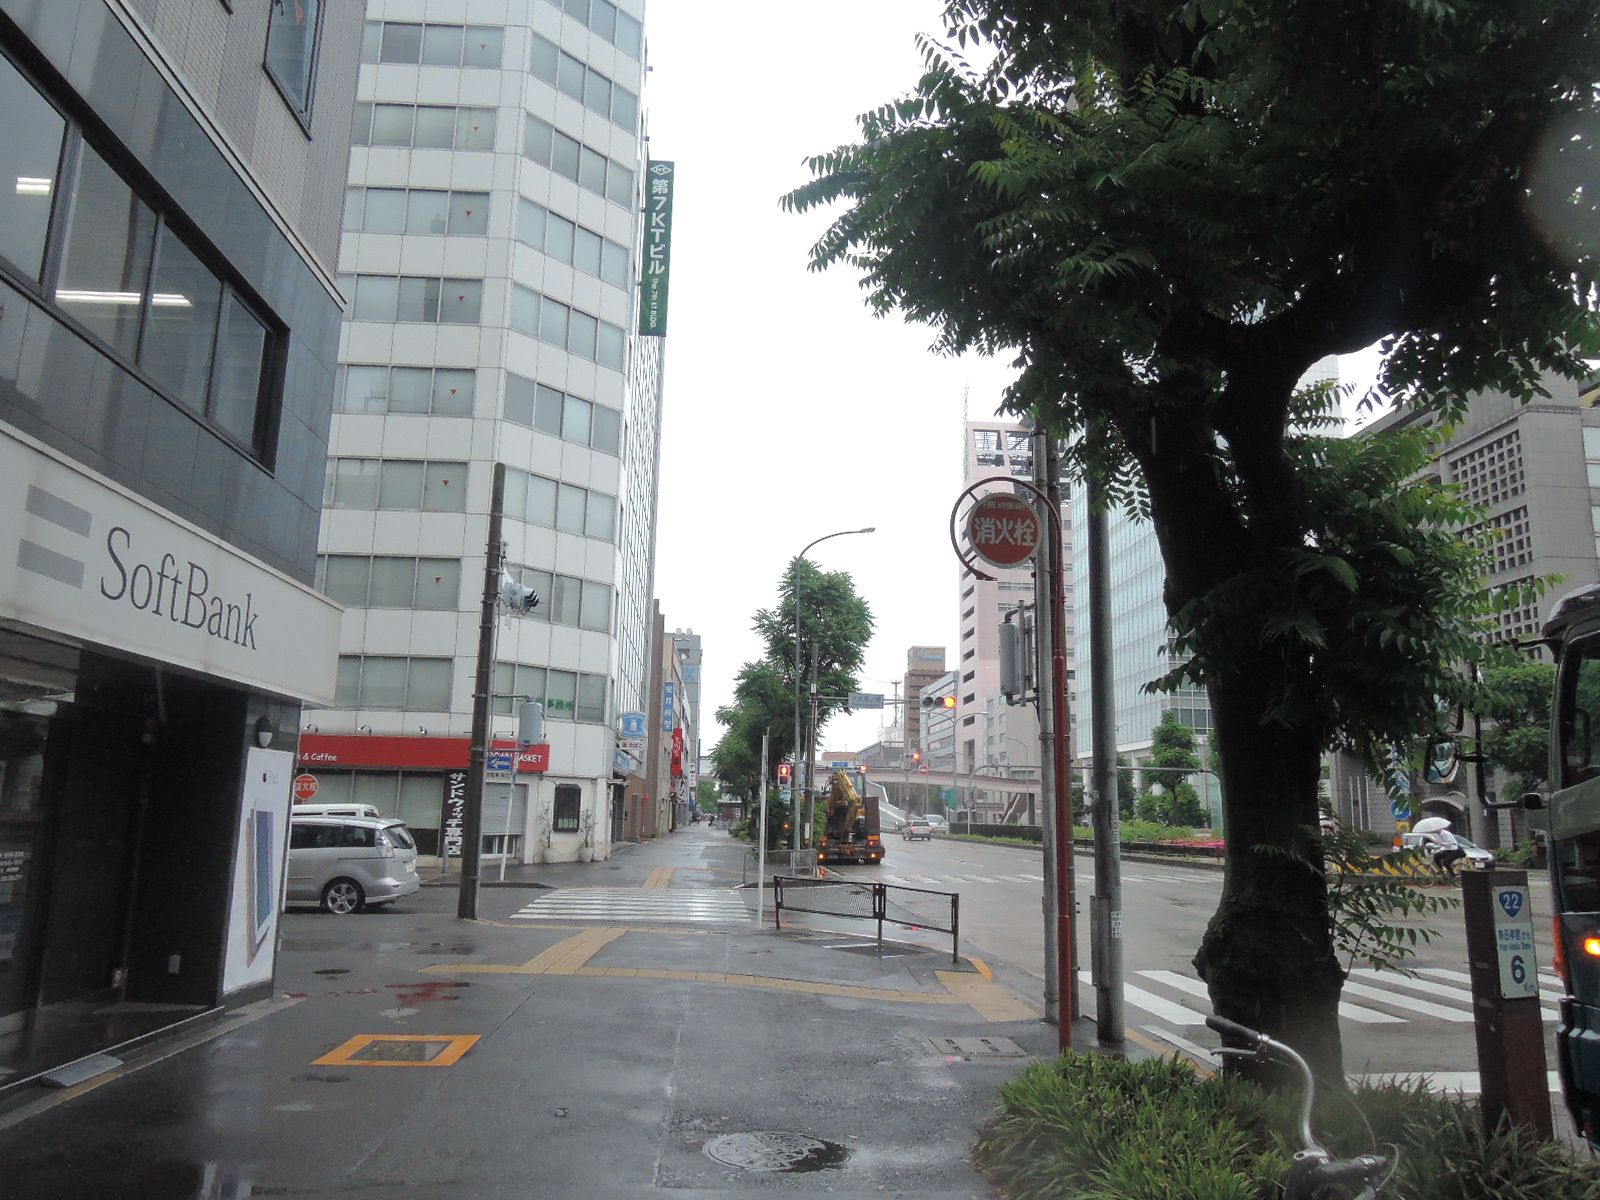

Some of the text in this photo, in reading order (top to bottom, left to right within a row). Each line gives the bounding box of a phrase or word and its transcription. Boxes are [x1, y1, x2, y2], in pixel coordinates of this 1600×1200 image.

[974, 517, 1035, 546] 消火栓
[100, 526, 259, 651] SoftBank
[311, 752, 337, 762] Coffee
[518, 754, 543, 763] ASKET
[1503, 894, 1520, 909] 22
[1511, 955, 1526, 984] 6
